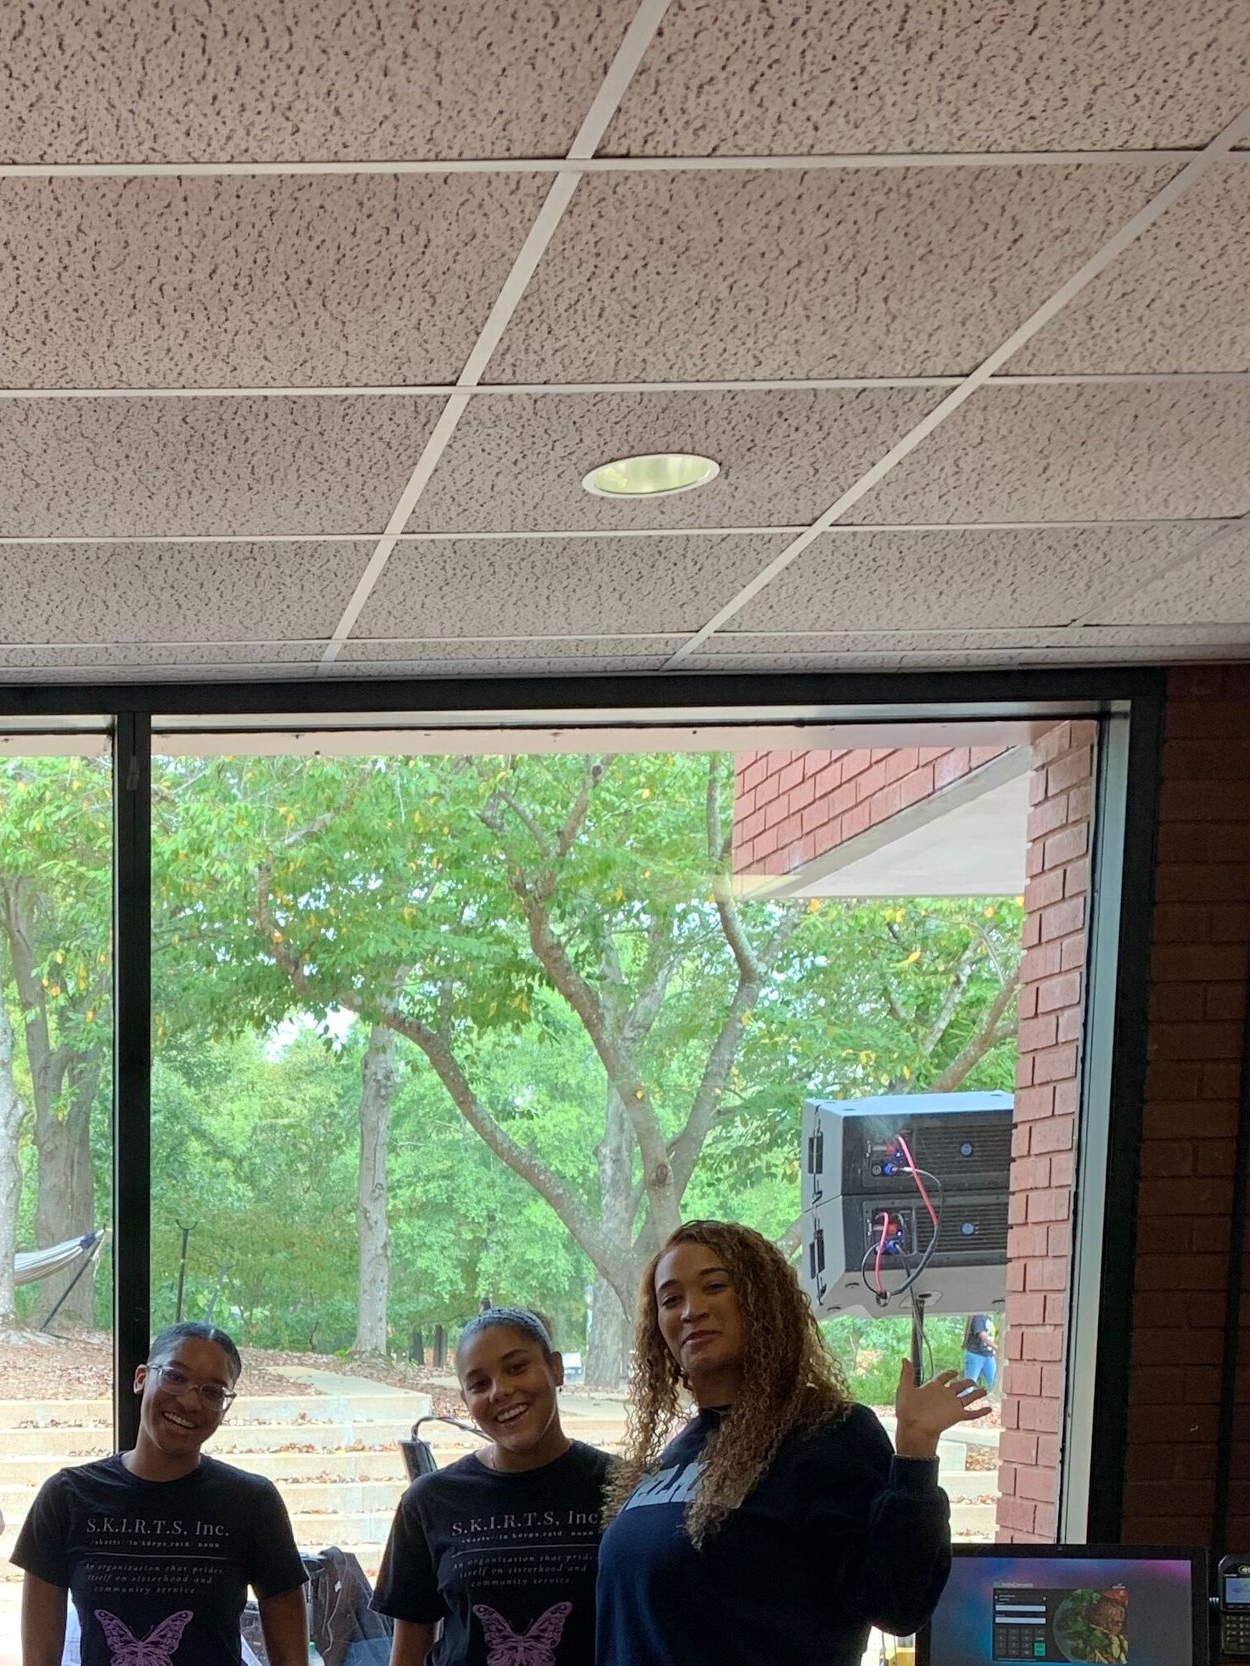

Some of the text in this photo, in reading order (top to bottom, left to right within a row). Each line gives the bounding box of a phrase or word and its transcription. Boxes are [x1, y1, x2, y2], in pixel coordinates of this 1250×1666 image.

[195, 1521, 229, 1537] Inc.
[467, 1555, 535, 1567] organization
[98, 1563, 160, 1573] organization
[166, 1564, 187, 1572] that
[508, 1564, 563, 1574] sisterhood
[568, 1563, 587, 1572] and
[132, 1574, 189, 1584] sisterhood
[193, 1576, 212, 1585] and
[471, 1577, 528, 1588] community
[94, 1585, 151, 1596] community
